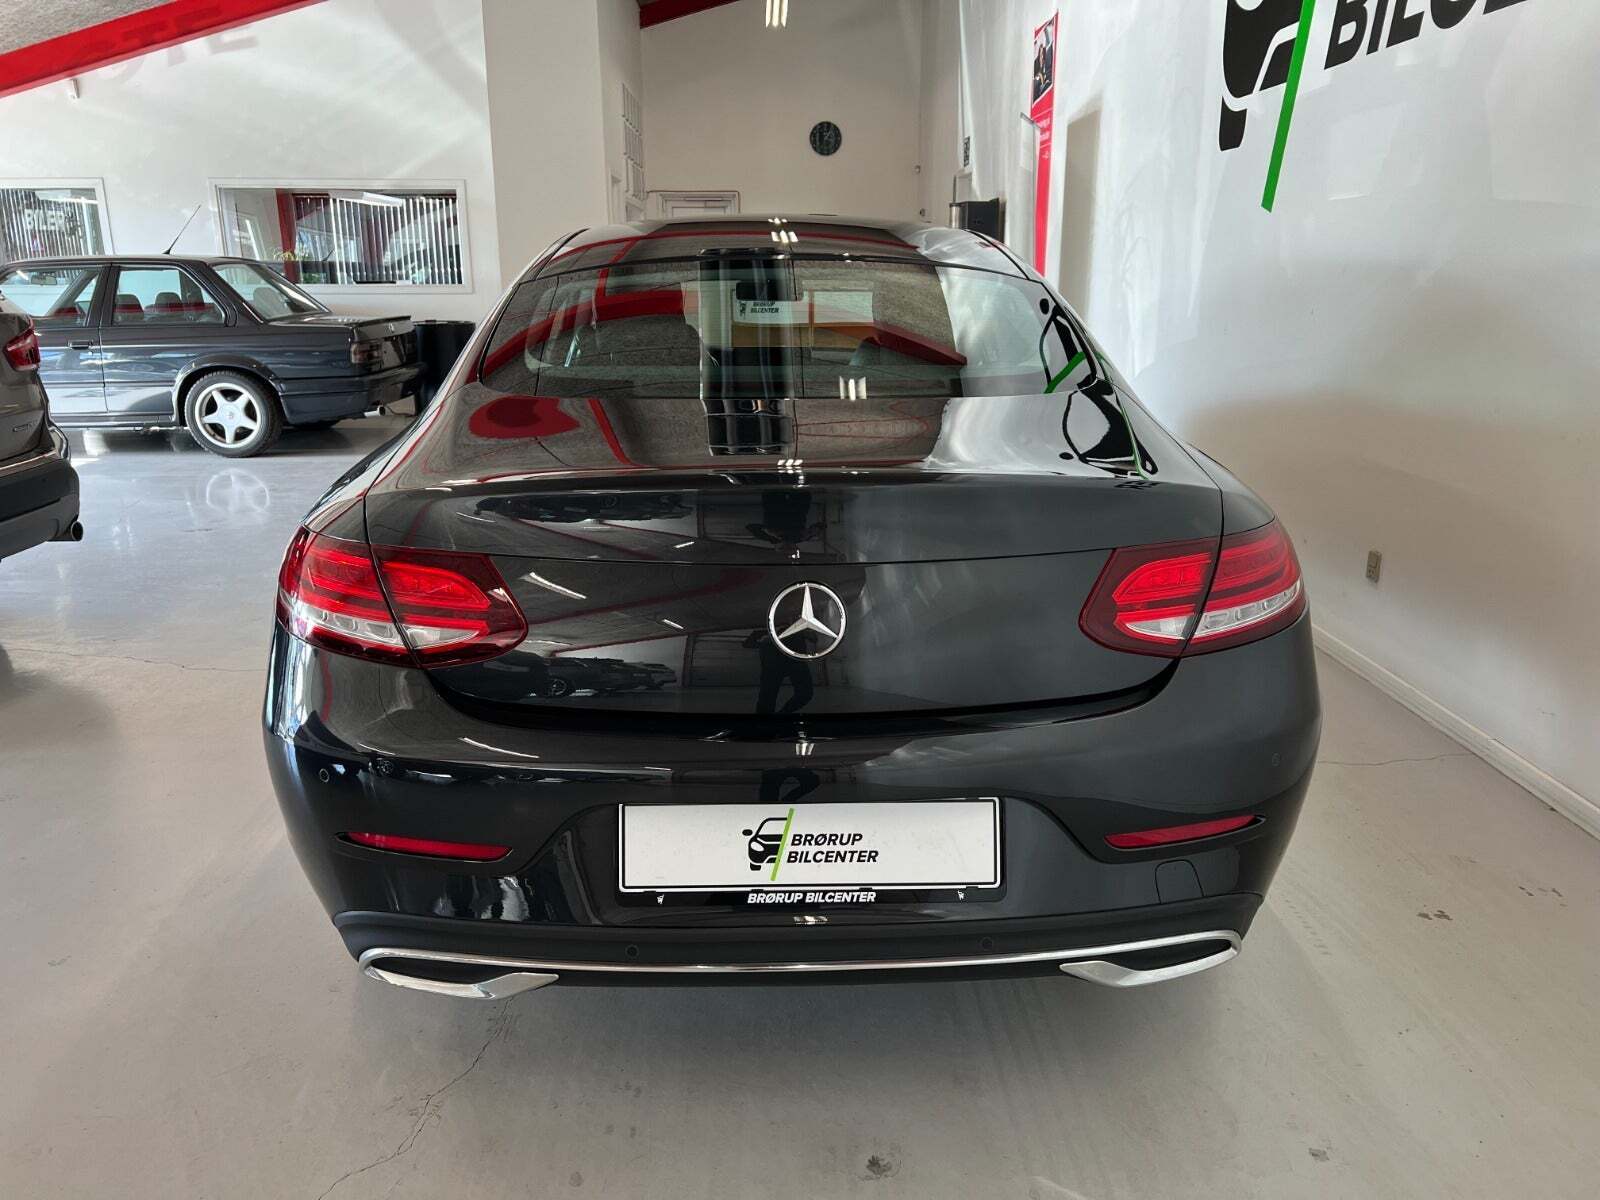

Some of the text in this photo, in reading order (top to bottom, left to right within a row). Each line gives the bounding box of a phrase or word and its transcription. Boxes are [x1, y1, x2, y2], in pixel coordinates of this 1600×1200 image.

[1324, 0, 1529, 70] BIL
[790, 833, 863, 847] BRØRUP
[786, 850, 879, 863] BILCENTER
[747, 891, 877, 904] BRØRUP BILCENTER
